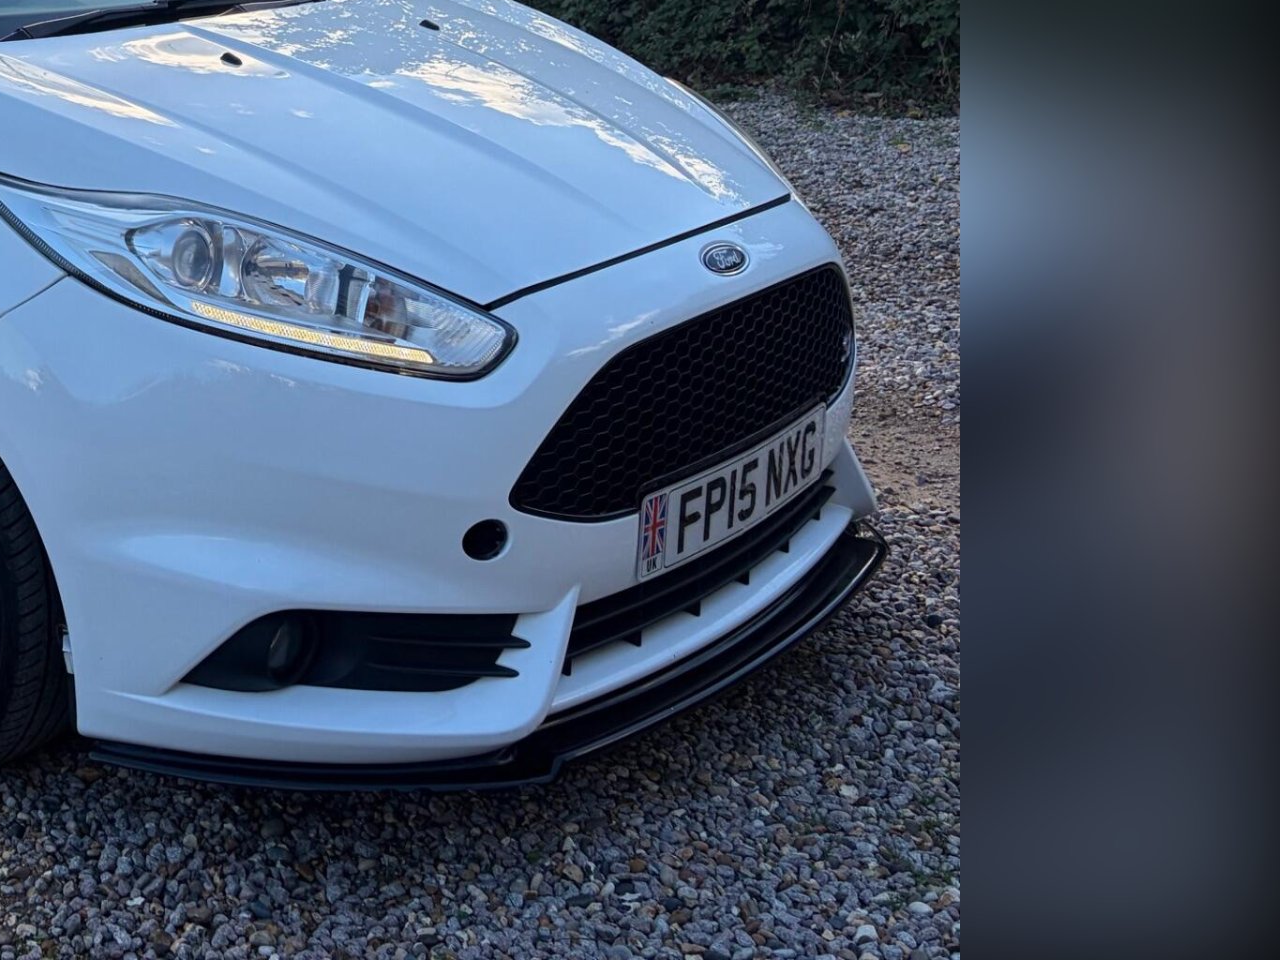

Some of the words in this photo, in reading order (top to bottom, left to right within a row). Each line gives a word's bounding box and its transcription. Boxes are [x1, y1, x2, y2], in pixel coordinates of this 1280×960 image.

[712, 249, 741, 269] Ford
[677, 458, 759, 555] FP15
[765, 420, 816, 507] NXG
[646, 556, 658, 572] UK
